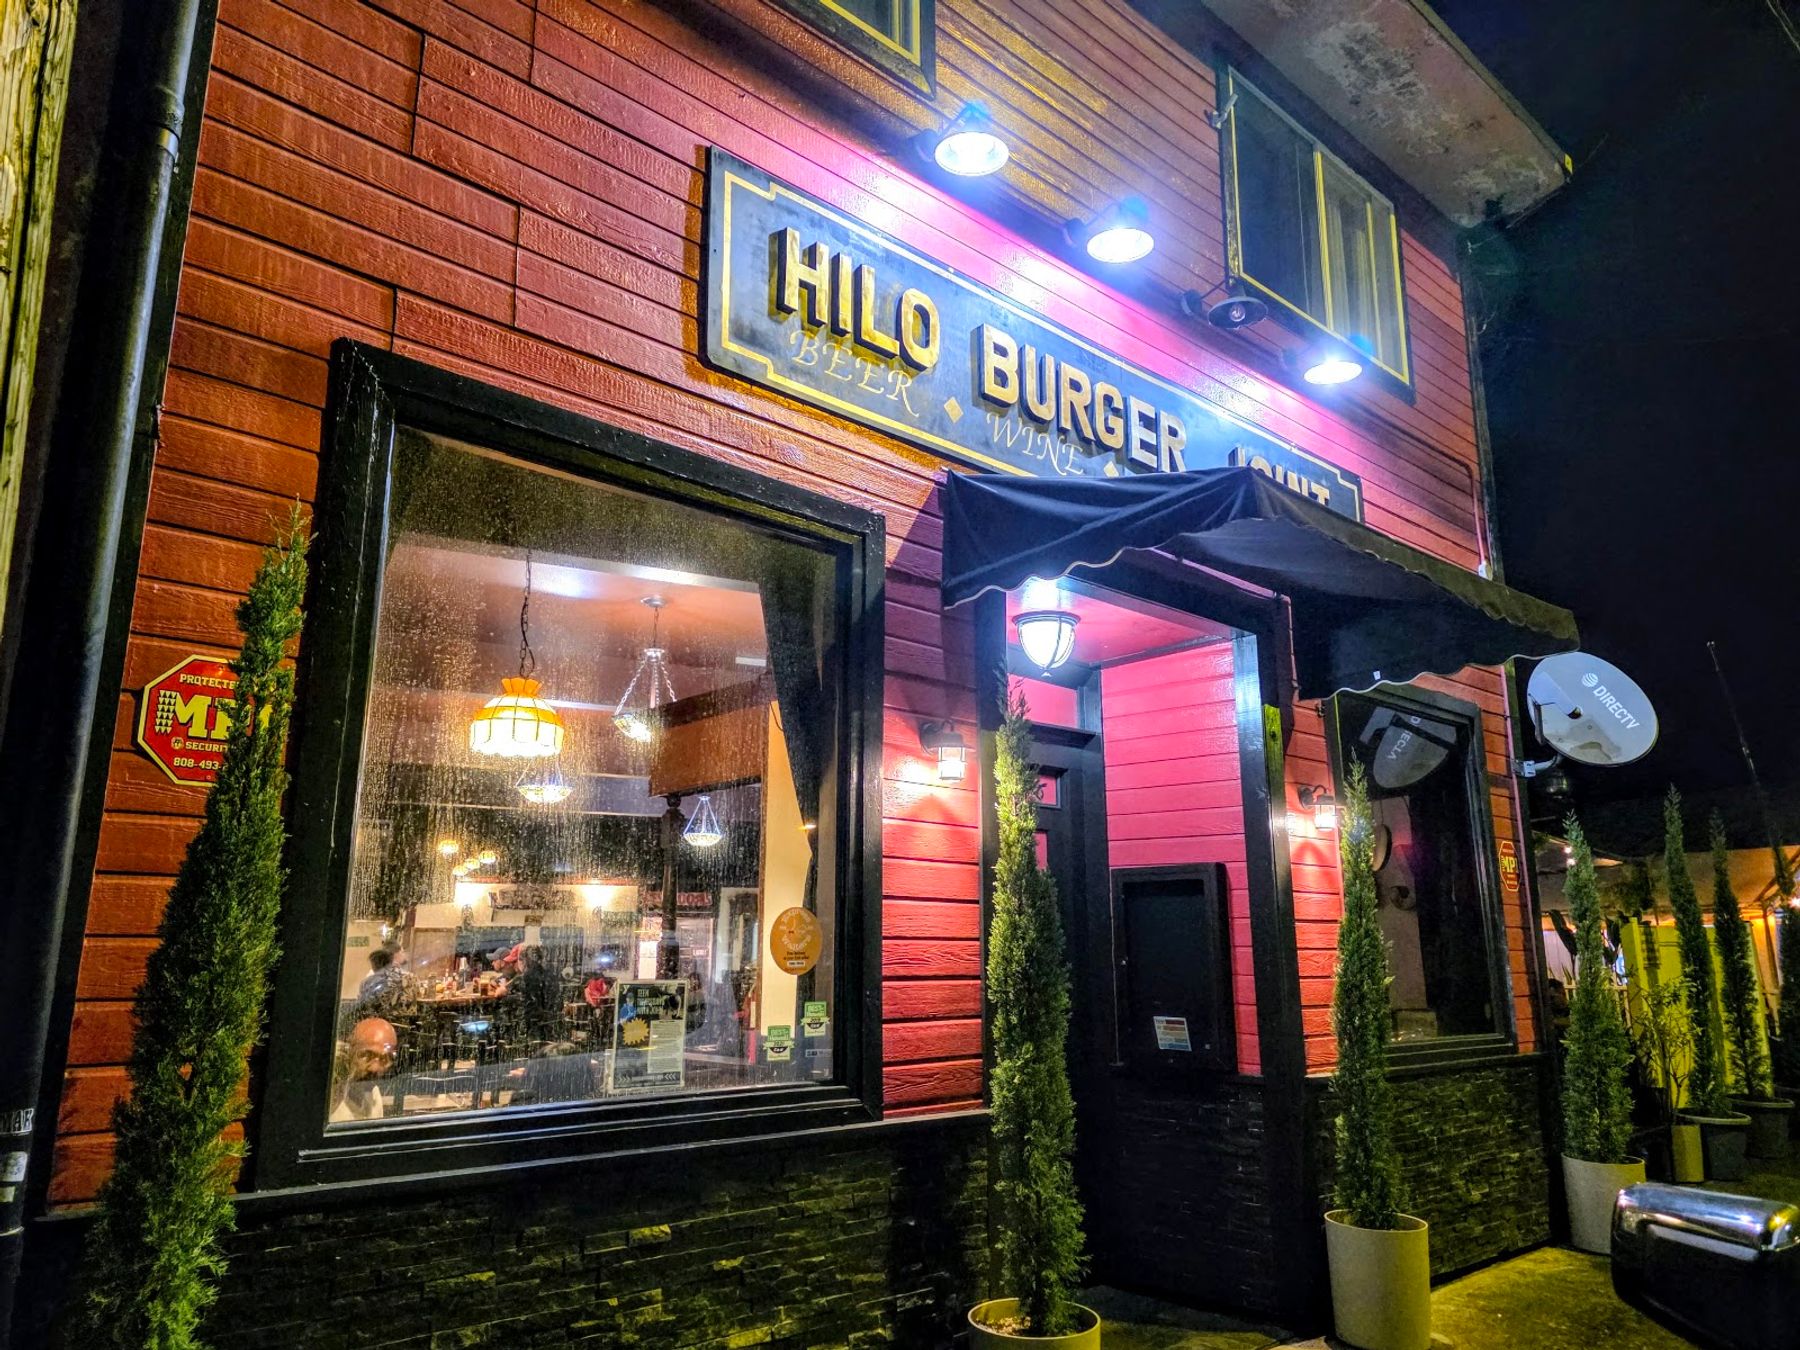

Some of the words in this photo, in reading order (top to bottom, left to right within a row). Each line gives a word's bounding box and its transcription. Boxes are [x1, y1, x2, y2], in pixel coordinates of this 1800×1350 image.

[778, 227, 940, 372] HILO
[978, 323, 1187, 473] BURGER
[790, 330, 919, 417] BEER
[986, 412, 1084, 476] WINE
[179, 673, 240, 690] PROTECTE
[1593, 685, 1640, 729] DIRECTV
[185, 741, 229, 753] SECURIT
[173, 757, 228, 770] 808-493-2
